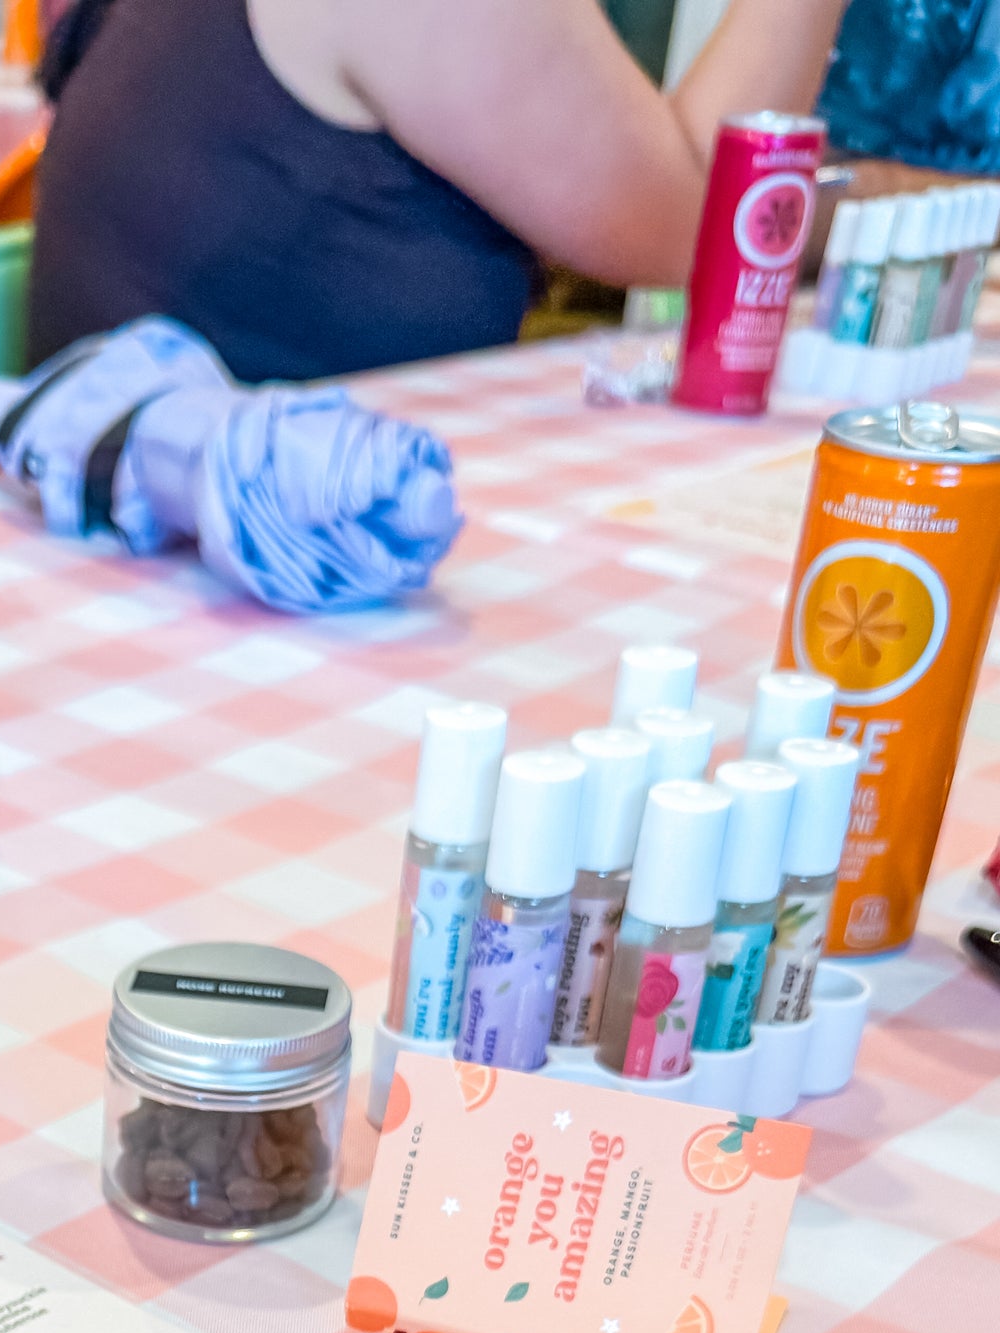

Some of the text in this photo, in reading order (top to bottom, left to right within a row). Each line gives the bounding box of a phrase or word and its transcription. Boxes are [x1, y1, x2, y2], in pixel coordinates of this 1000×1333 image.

[389, 1212, 404, 1240] SUN
[395, 1163, 415, 1210] KISSED
[484, 1131, 539, 1272] orange
[527, 1172, 564, 1251] you
[553, 1129, 625, 1303] amazing
[603, 1165, 644, 1286] ORANGE, MANGO,
[621, 1178, 655, 1279] PASSIONFRUIT
